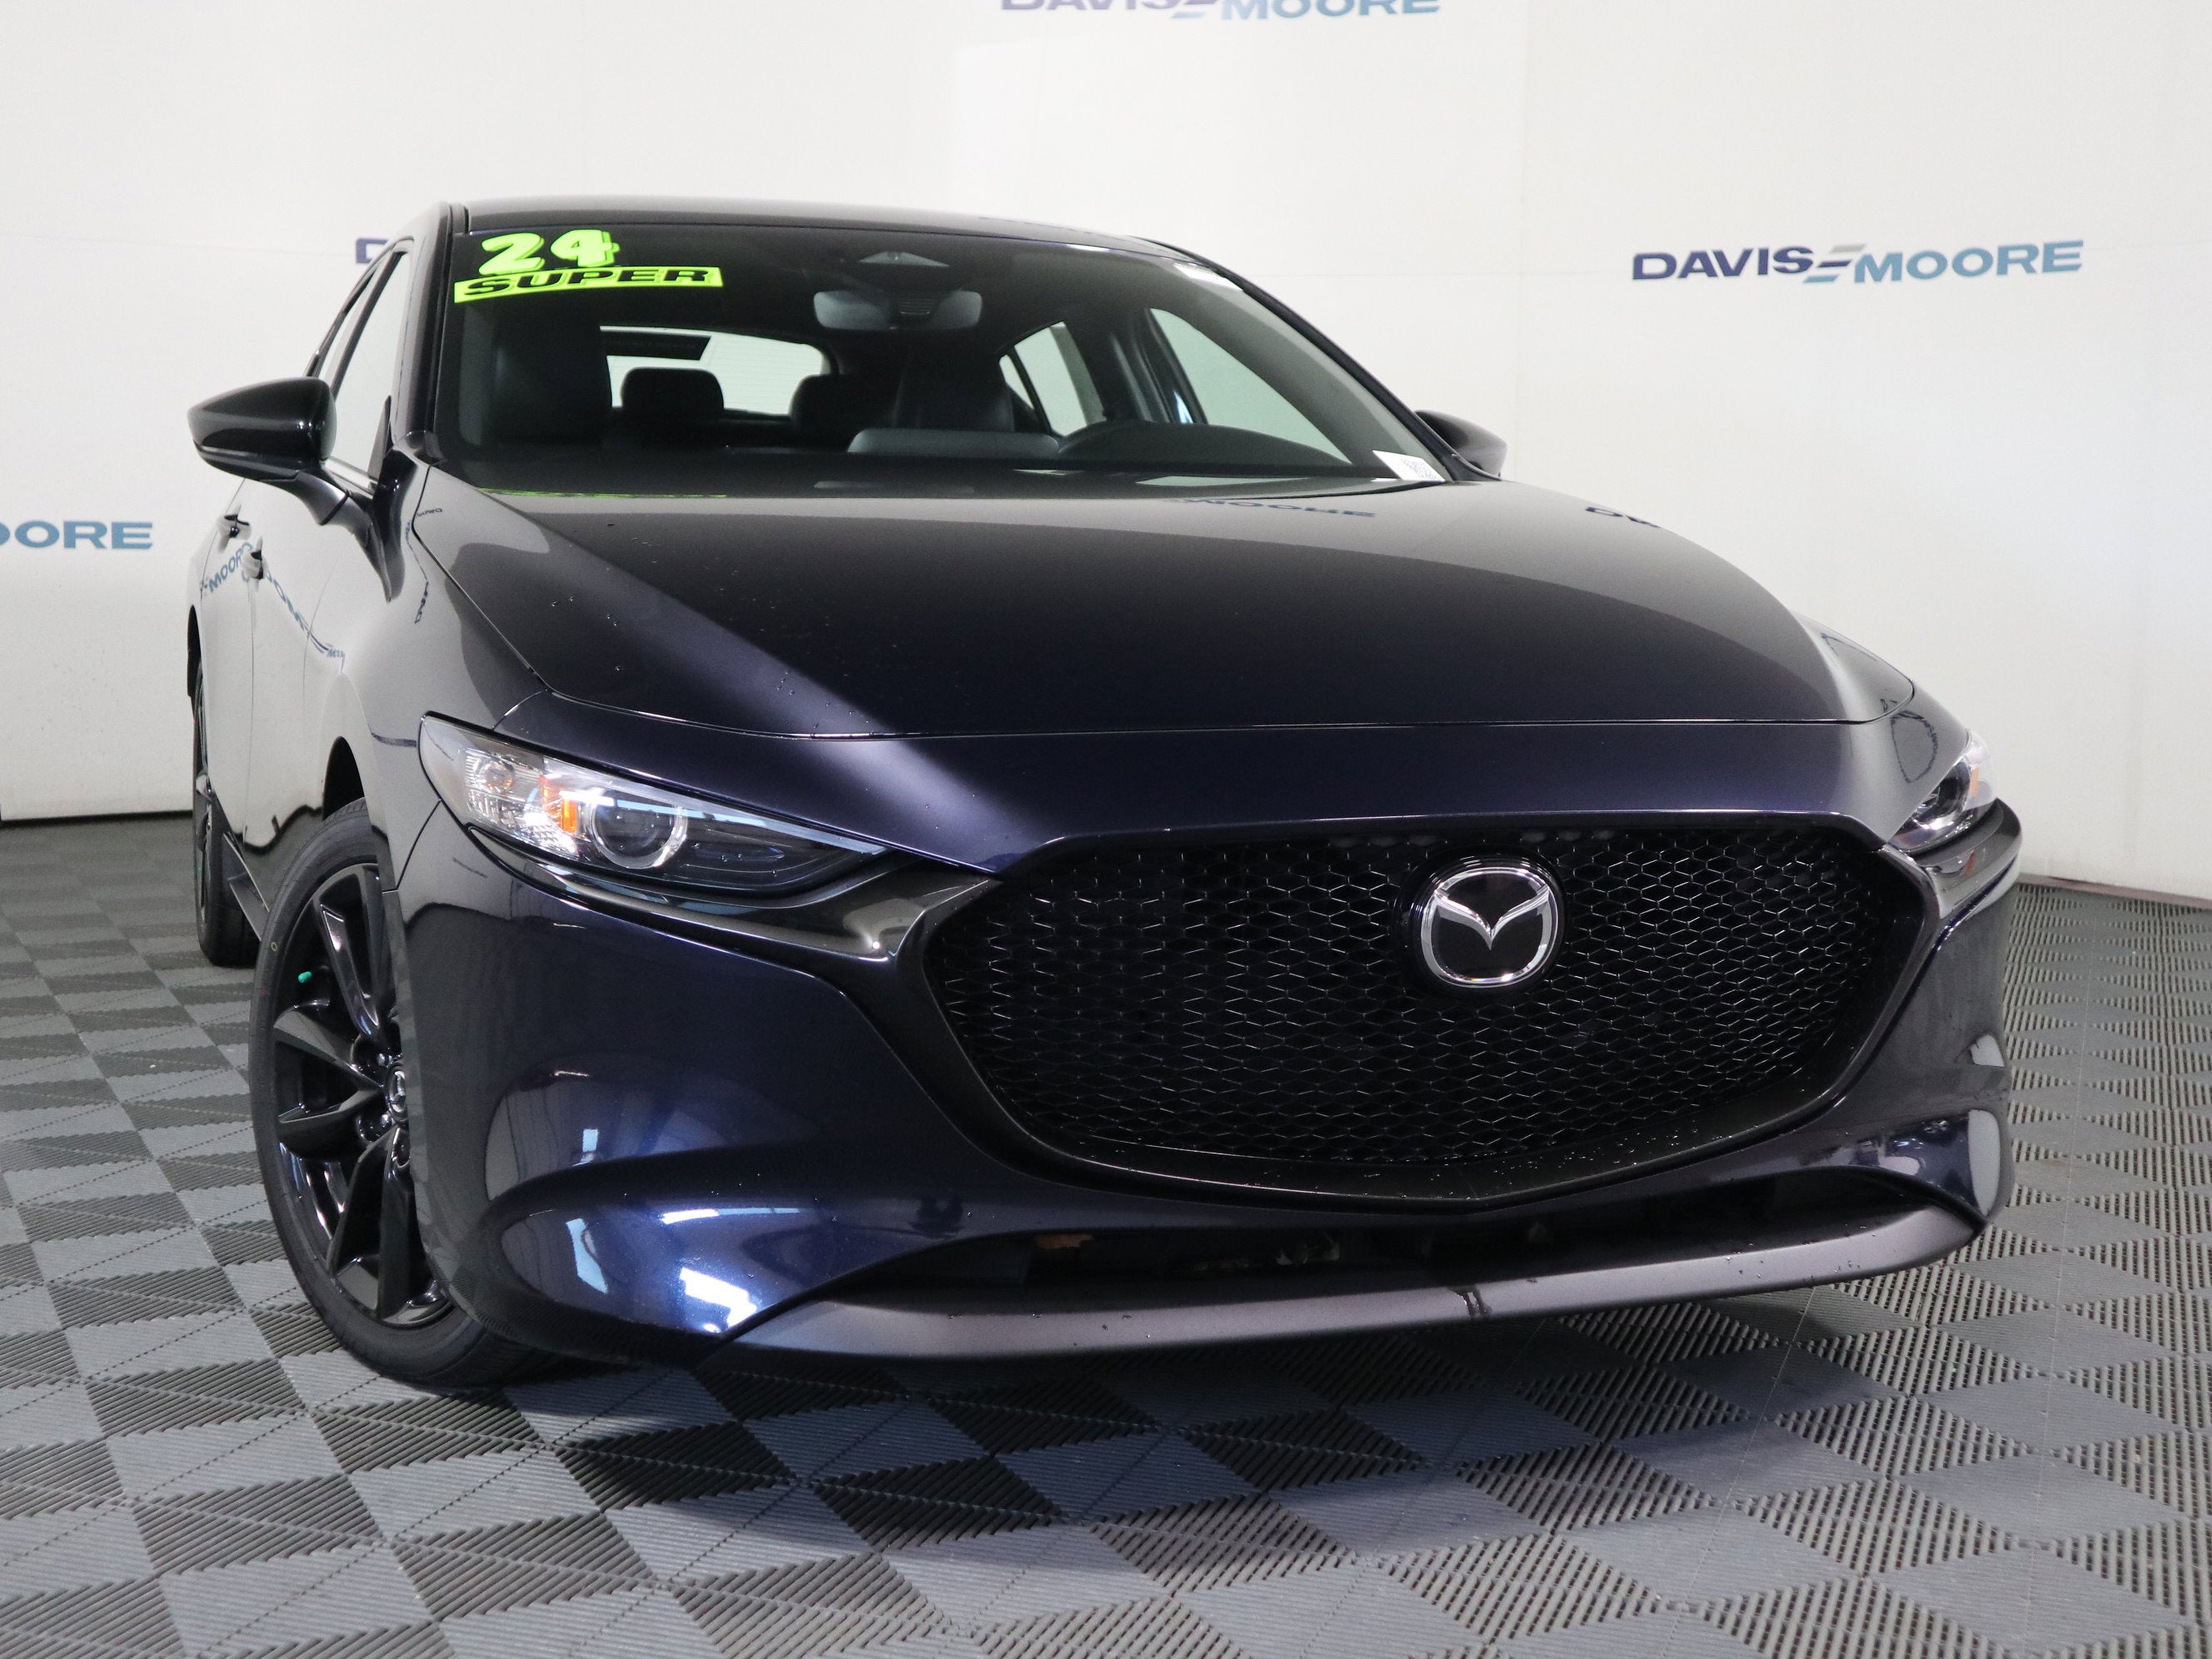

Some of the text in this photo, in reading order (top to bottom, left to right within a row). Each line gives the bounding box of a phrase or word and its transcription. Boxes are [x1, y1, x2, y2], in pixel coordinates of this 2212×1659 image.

[478, 229, 621, 276] 24
[1632, 240, 2085, 284] DAVIS MOORE
[463, 267, 710, 296] SUPER
[0, 520, 154, 551] ORE
